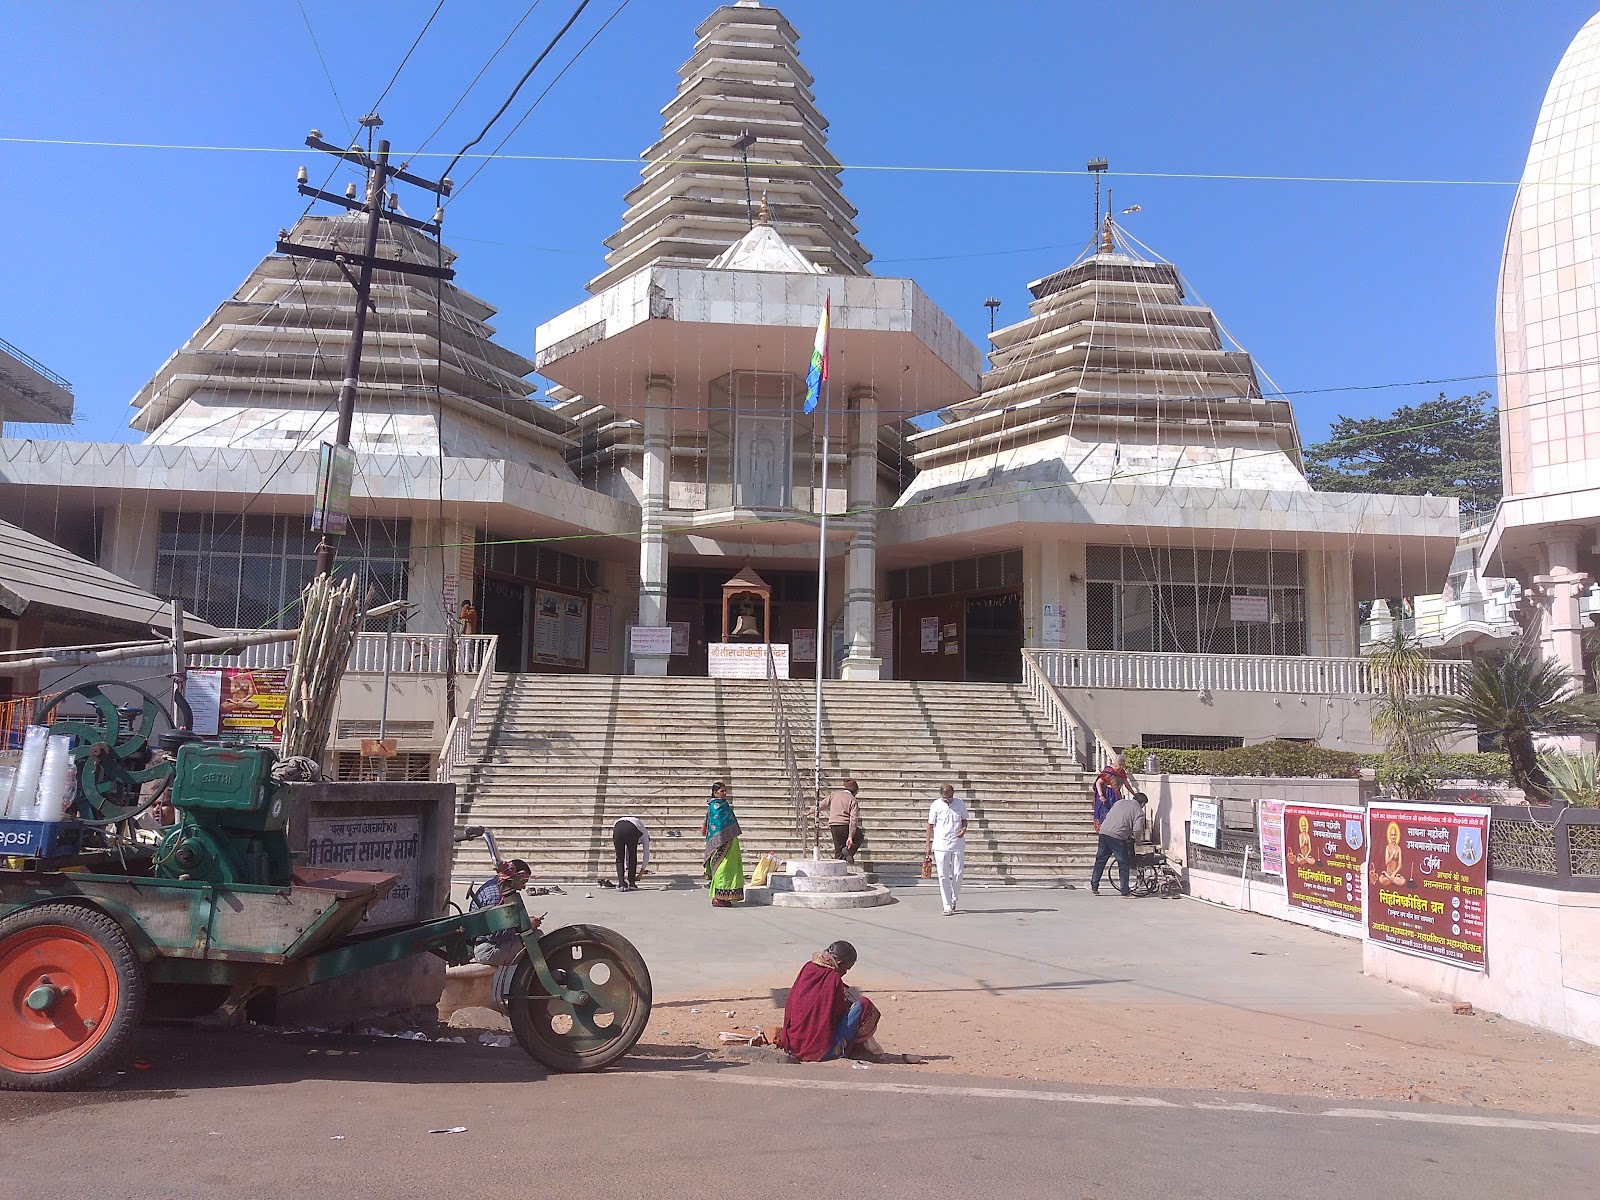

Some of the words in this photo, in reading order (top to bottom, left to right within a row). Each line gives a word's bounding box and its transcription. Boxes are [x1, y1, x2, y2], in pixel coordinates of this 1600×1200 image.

[346, 824, 361, 838] पूज्य
[362, 820, 385, 834] आचार्य
[319, 838, 358, 864] विमल
[359, 840, 394, 861] सागर
[394, 833, 419, 860] मार्ग
[1430, 900, 1445, 915] व्रत
